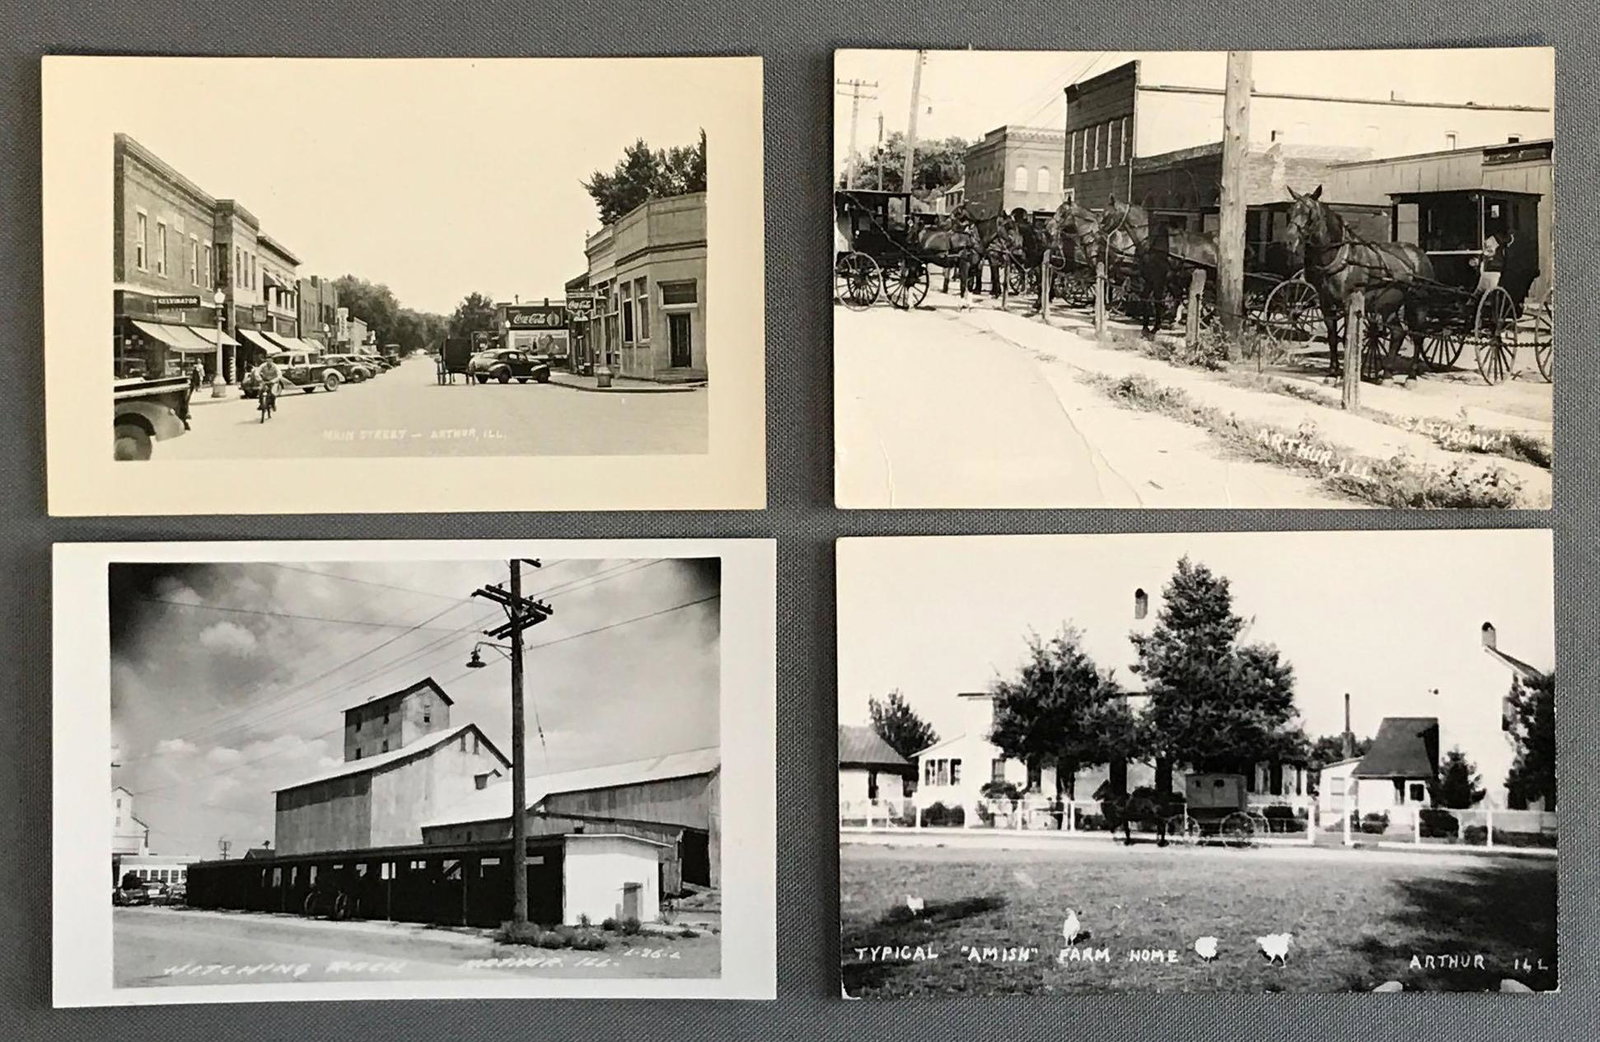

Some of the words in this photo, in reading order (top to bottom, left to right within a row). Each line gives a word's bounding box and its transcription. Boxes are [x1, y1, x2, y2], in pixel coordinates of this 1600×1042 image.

[322, 429, 355, 442] MAIN
[359, 429, 408, 441] STREET
[854, 946, 940, 962] TYPICAL
[960, 946, 1039, 963] "AMISH"
[1058, 947, 1111, 964] FARM
[1129, 948, 1179, 963] HOME
[1409, 954, 1486, 970] ARTHUR
[163, 963, 312, 978] HITCHING
